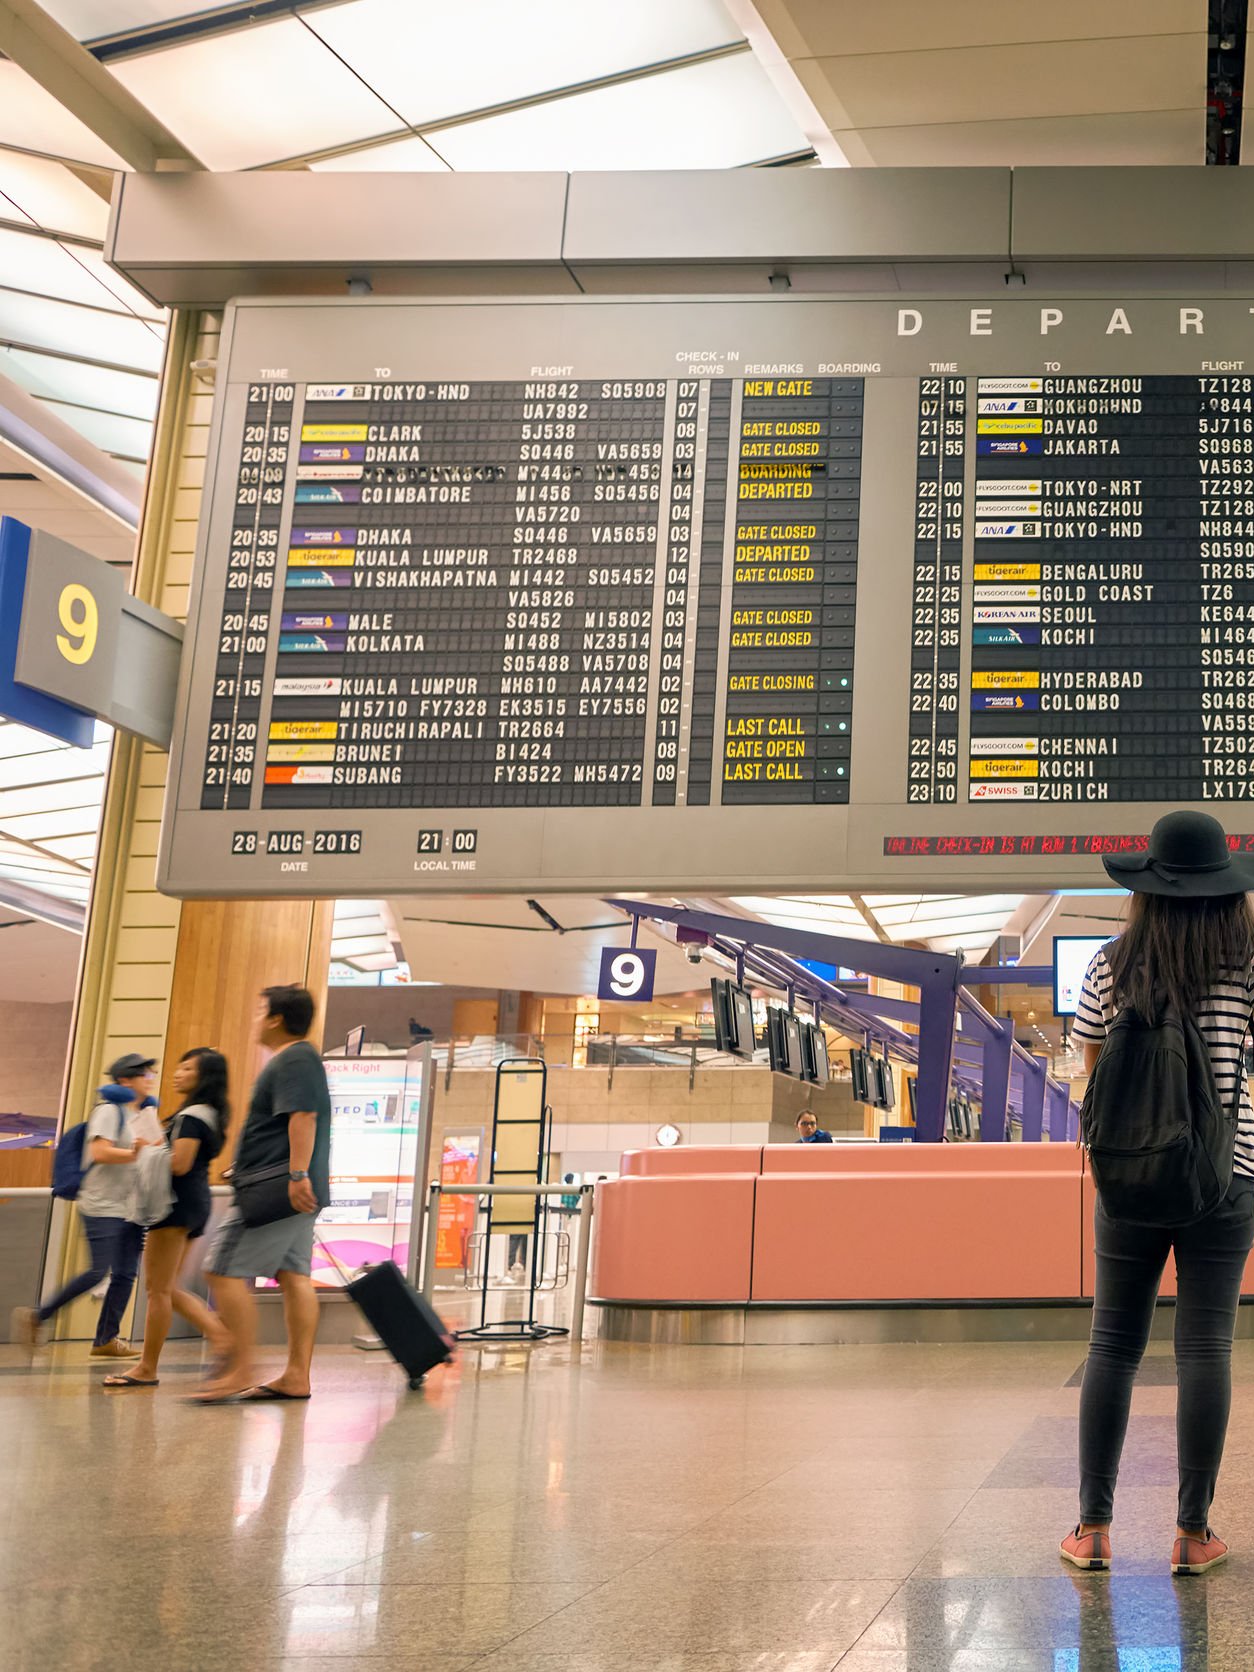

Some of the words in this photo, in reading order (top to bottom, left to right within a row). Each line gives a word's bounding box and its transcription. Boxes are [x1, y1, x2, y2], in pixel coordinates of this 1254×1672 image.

[260, 368, 288, 379] TIME
[374, 367, 391, 378] TO
[530, 365, 574, 377] FLIGHT
[688, 364, 724, 375] ROWS
[744, 363, 804, 374] REMARKS
[817, 363, 881, 374] BOARDING
[928, 362, 958, 373] TIME
[1043, 361, 1061, 372] TO
[1201, 360, 1245, 371] FLIGHT
[372, 384, 470, 401] TOKYO-HND
[524, 383, 579, 399] NH842
[601, 382, 666, 399] SQ5908
[745, 381, 774, 396] NEW
[777, 380, 812, 396] GATE
[1044, 378, 1142, 394] GUANGZHOU
[1198, 378, 1252, 393] TZ128
[522, 403, 589, 420] UA7992
[983, 402, 1007, 412] ANA
[368, 425, 422, 442] CLARK
[521, 423, 576, 440] 5J538
[742, 422, 773, 436] GATE
[775, 422, 821, 436] CLOSED
[1043, 419, 1098, 435] DAVAO
[1198, 418, 1253, 434] 5J716
[365, 445, 420, 462] DHAKA
[597, 443, 662, 460] VA5659
[1043, 439, 1120, 455] JAKARTA
[1199, 438, 1253, 454] SQ968
[361, 486, 472, 504] COIMBATORE
[515, 485, 571, 502] MI456
[739, 482, 813, 499] DEPARTED
[1043, 480, 1142, 497] TOKYO-NRT
[1042, 521, 1143, 539] TOKYO-HND
[354, 549, 410, 567] KUALA
[422, 549, 489, 566] LUMPUR
[512, 548, 578, 565] TR2468
[354, 570, 497, 588] VISHAKHAPATNA
[1042, 563, 1143, 581] BENGALURU
[1042, 585, 1086, 602] GOLD
[1098, 585, 1154, 602] COAST
[1200, 584, 1233, 601] TZ6
[348, 613, 393, 631] MALE
[1042, 606, 1097, 624] SEOUL
[56, 583, 98, 665] 9
[346, 634, 424, 652] KOLKATA
[583, 632, 650, 650] NZ3514
[1041, 628, 1094, 645] KOCHI
[579, 676, 648, 694] AA7442
[729, 675, 759, 690] GATE
[762, 675, 814, 690] CLOSING
[1040, 671, 1143, 689] HYDERABAD
[419, 699, 487, 717] FY7328
[578, 697, 646, 716] EY7556
[1041, 693, 1120, 711] COLOMBO
[339, 721, 483, 740] TIRUCHIRAPALI
[727, 718, 765, 736] LAST
[768, 718, 805, 736] CALL
[335, 744, 401, 762] BRUNEI
[726, 741, 763, 758] GATE
[766, 740, 805, 758] OPEN
[1040, 737, 1117, 756] CHENNAI
[333, 766, 402, 785] SUBANG
[494, 765, 562, 783] FY3522
[574, 764, 642, 783] MH5472
[985, 761, 1024, 773] tigerair
[988, 786, 1018, 795] SWISS
[1039, 782, 1108, 801] ZURICH
[280, 861, 308, 872] DATE
[413, 861, 449, 871] LOCAL
[450, 860, 476, 871] TIME
[609, 953, 645, 997] 9
[352, 1063, 380, 1074] Right
